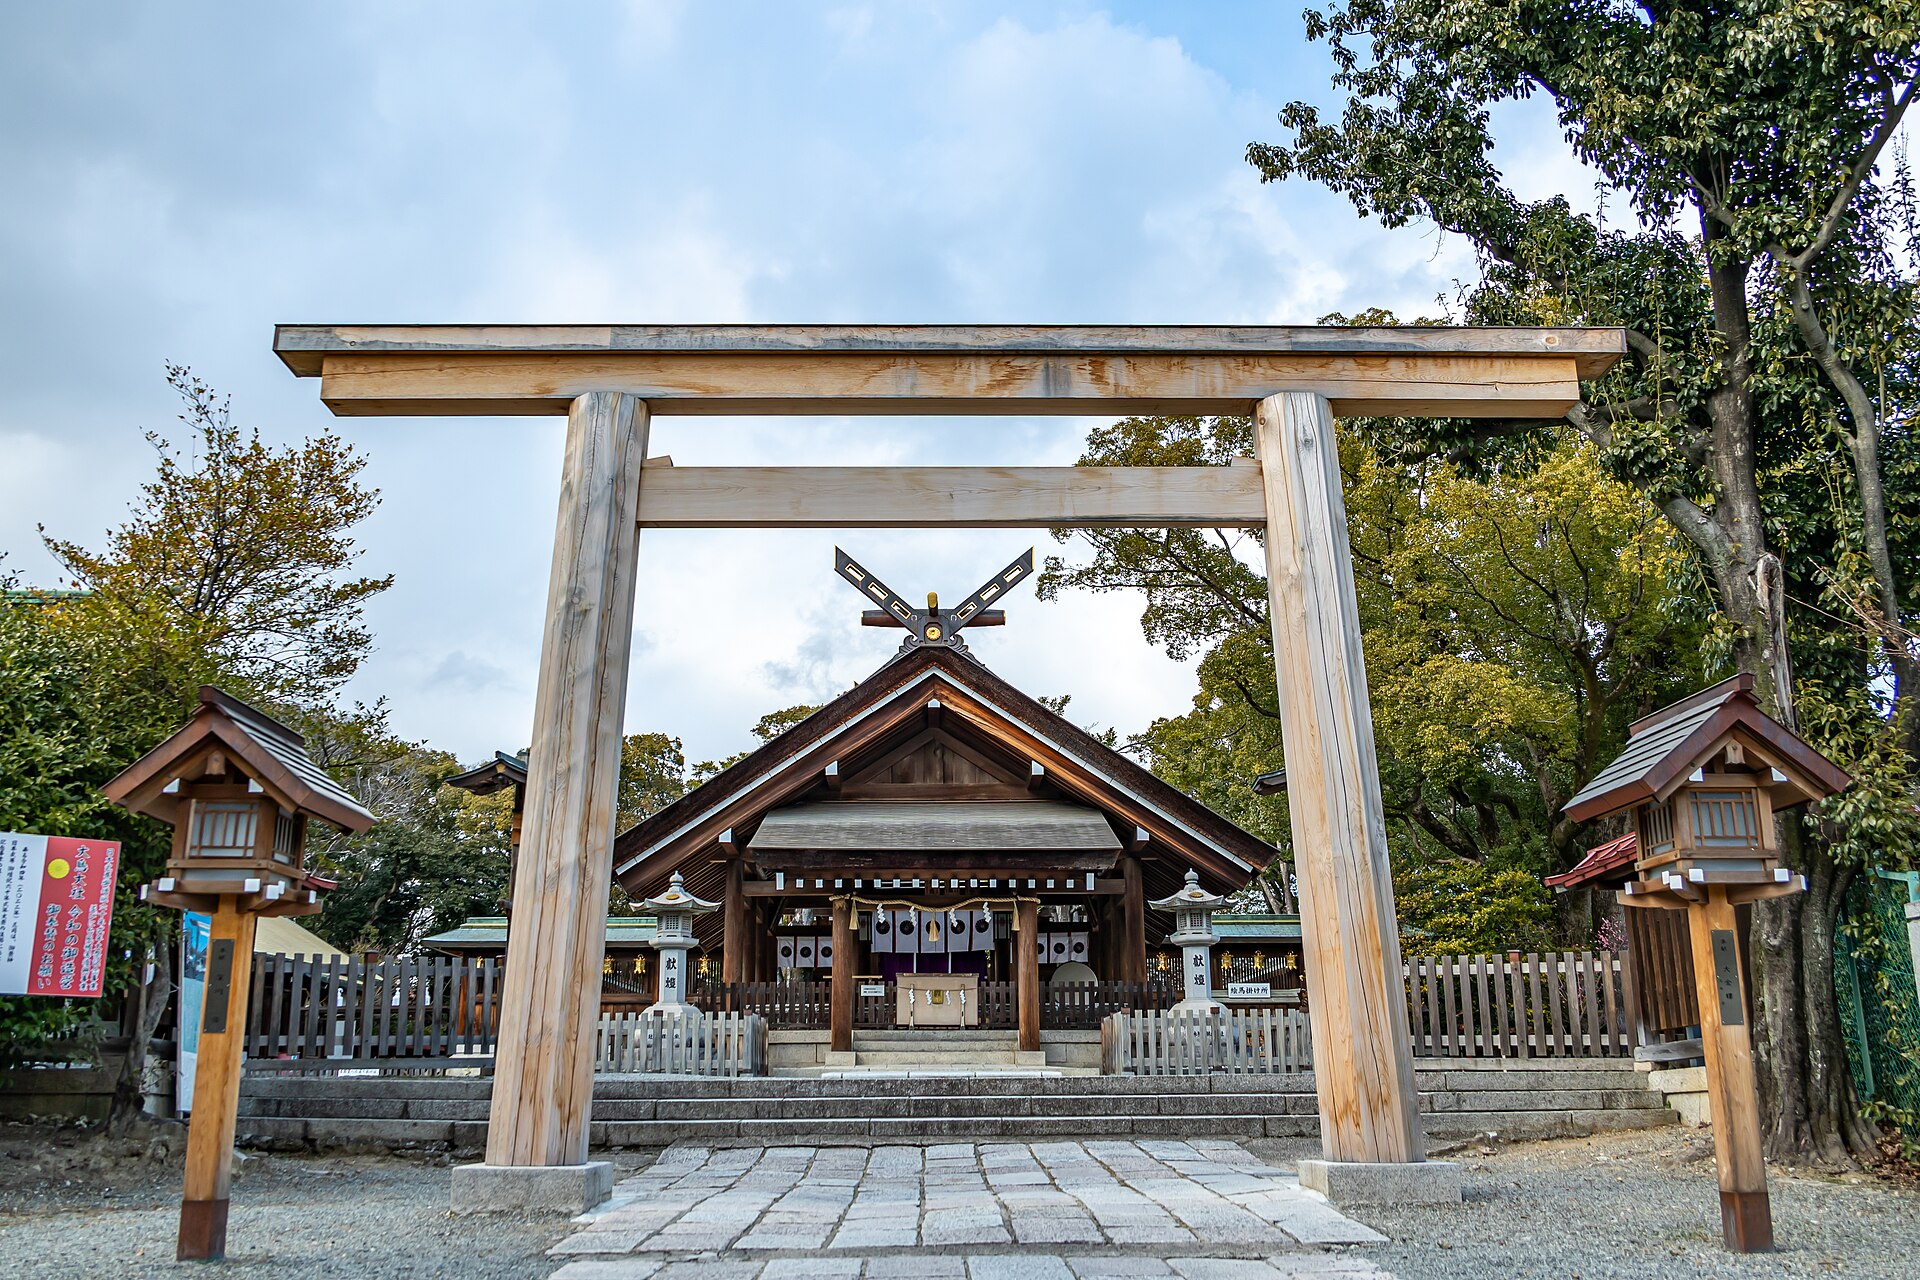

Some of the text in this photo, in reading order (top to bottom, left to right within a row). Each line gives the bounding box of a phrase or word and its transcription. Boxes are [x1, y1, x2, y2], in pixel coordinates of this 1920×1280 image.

[68, 844, 91, 900] 大鳥大社
[1230, 986, 1269, 995] 絵馬掛け所
